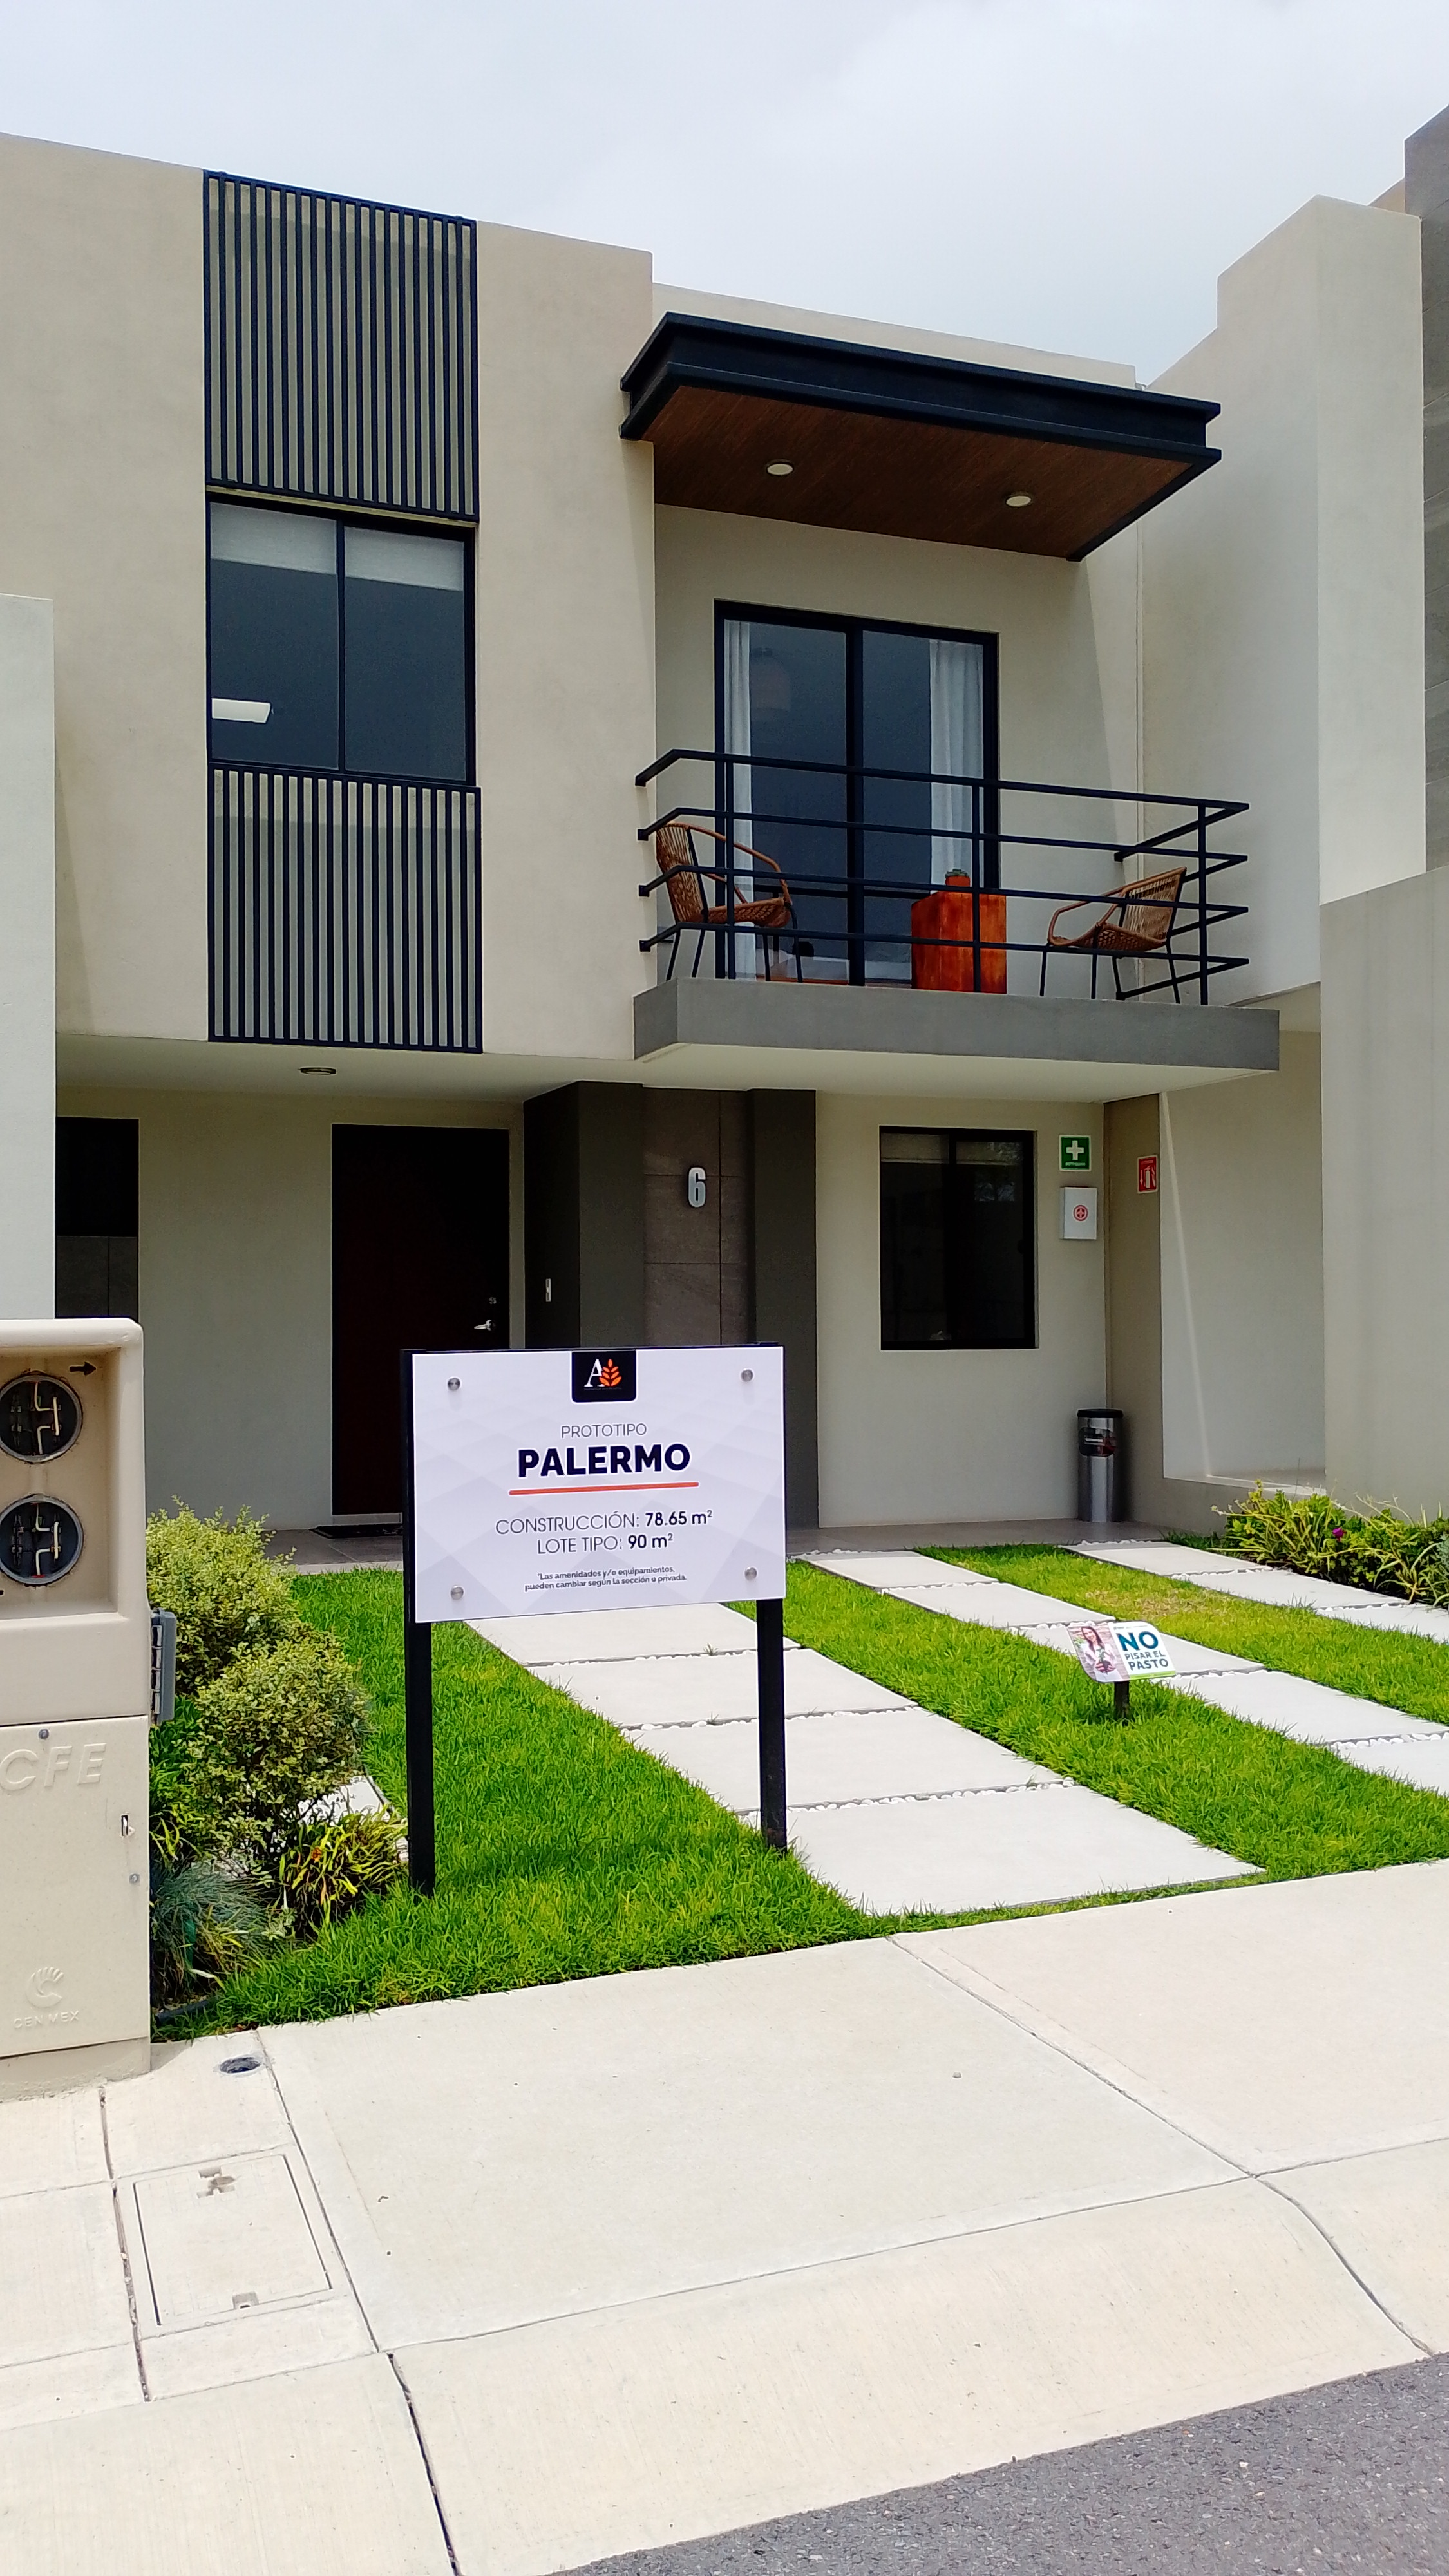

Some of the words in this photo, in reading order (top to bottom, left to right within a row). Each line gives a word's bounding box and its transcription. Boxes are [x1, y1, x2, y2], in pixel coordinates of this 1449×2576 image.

[688, 1166, 706, 1208] 6
[561, 1423, 647, 1439] PROTOTIPO
[518, 1443, 691, 1478] PALERMO
[495, 1511, 640, 1535] CONSTRUCCIÓN:
[645, 1511, 687, 1528] 78.65
[537, 1537, 577, 1555] LOTE
[582, 1535, 623, 1553] TIPO:
[627, 1534, 647, 1549] 90
[524, 1582, 554, 1592] pueden
[555, 1580, 587, 1589] cambiar
[587, 1578, 611, 1587] según
[621, 1575, 650, 1585] sección
[554, 1569, 601, 1580] amenidades
[602, 1568, 617, 1578] y/o
[1115, 1631, 1159, 1652] NO
[1124, 1651, 1152, 1660] PISAR
[1127, 1658, 1169, 1671] PASTO
[0, 1742, 108, 1792] CFE
